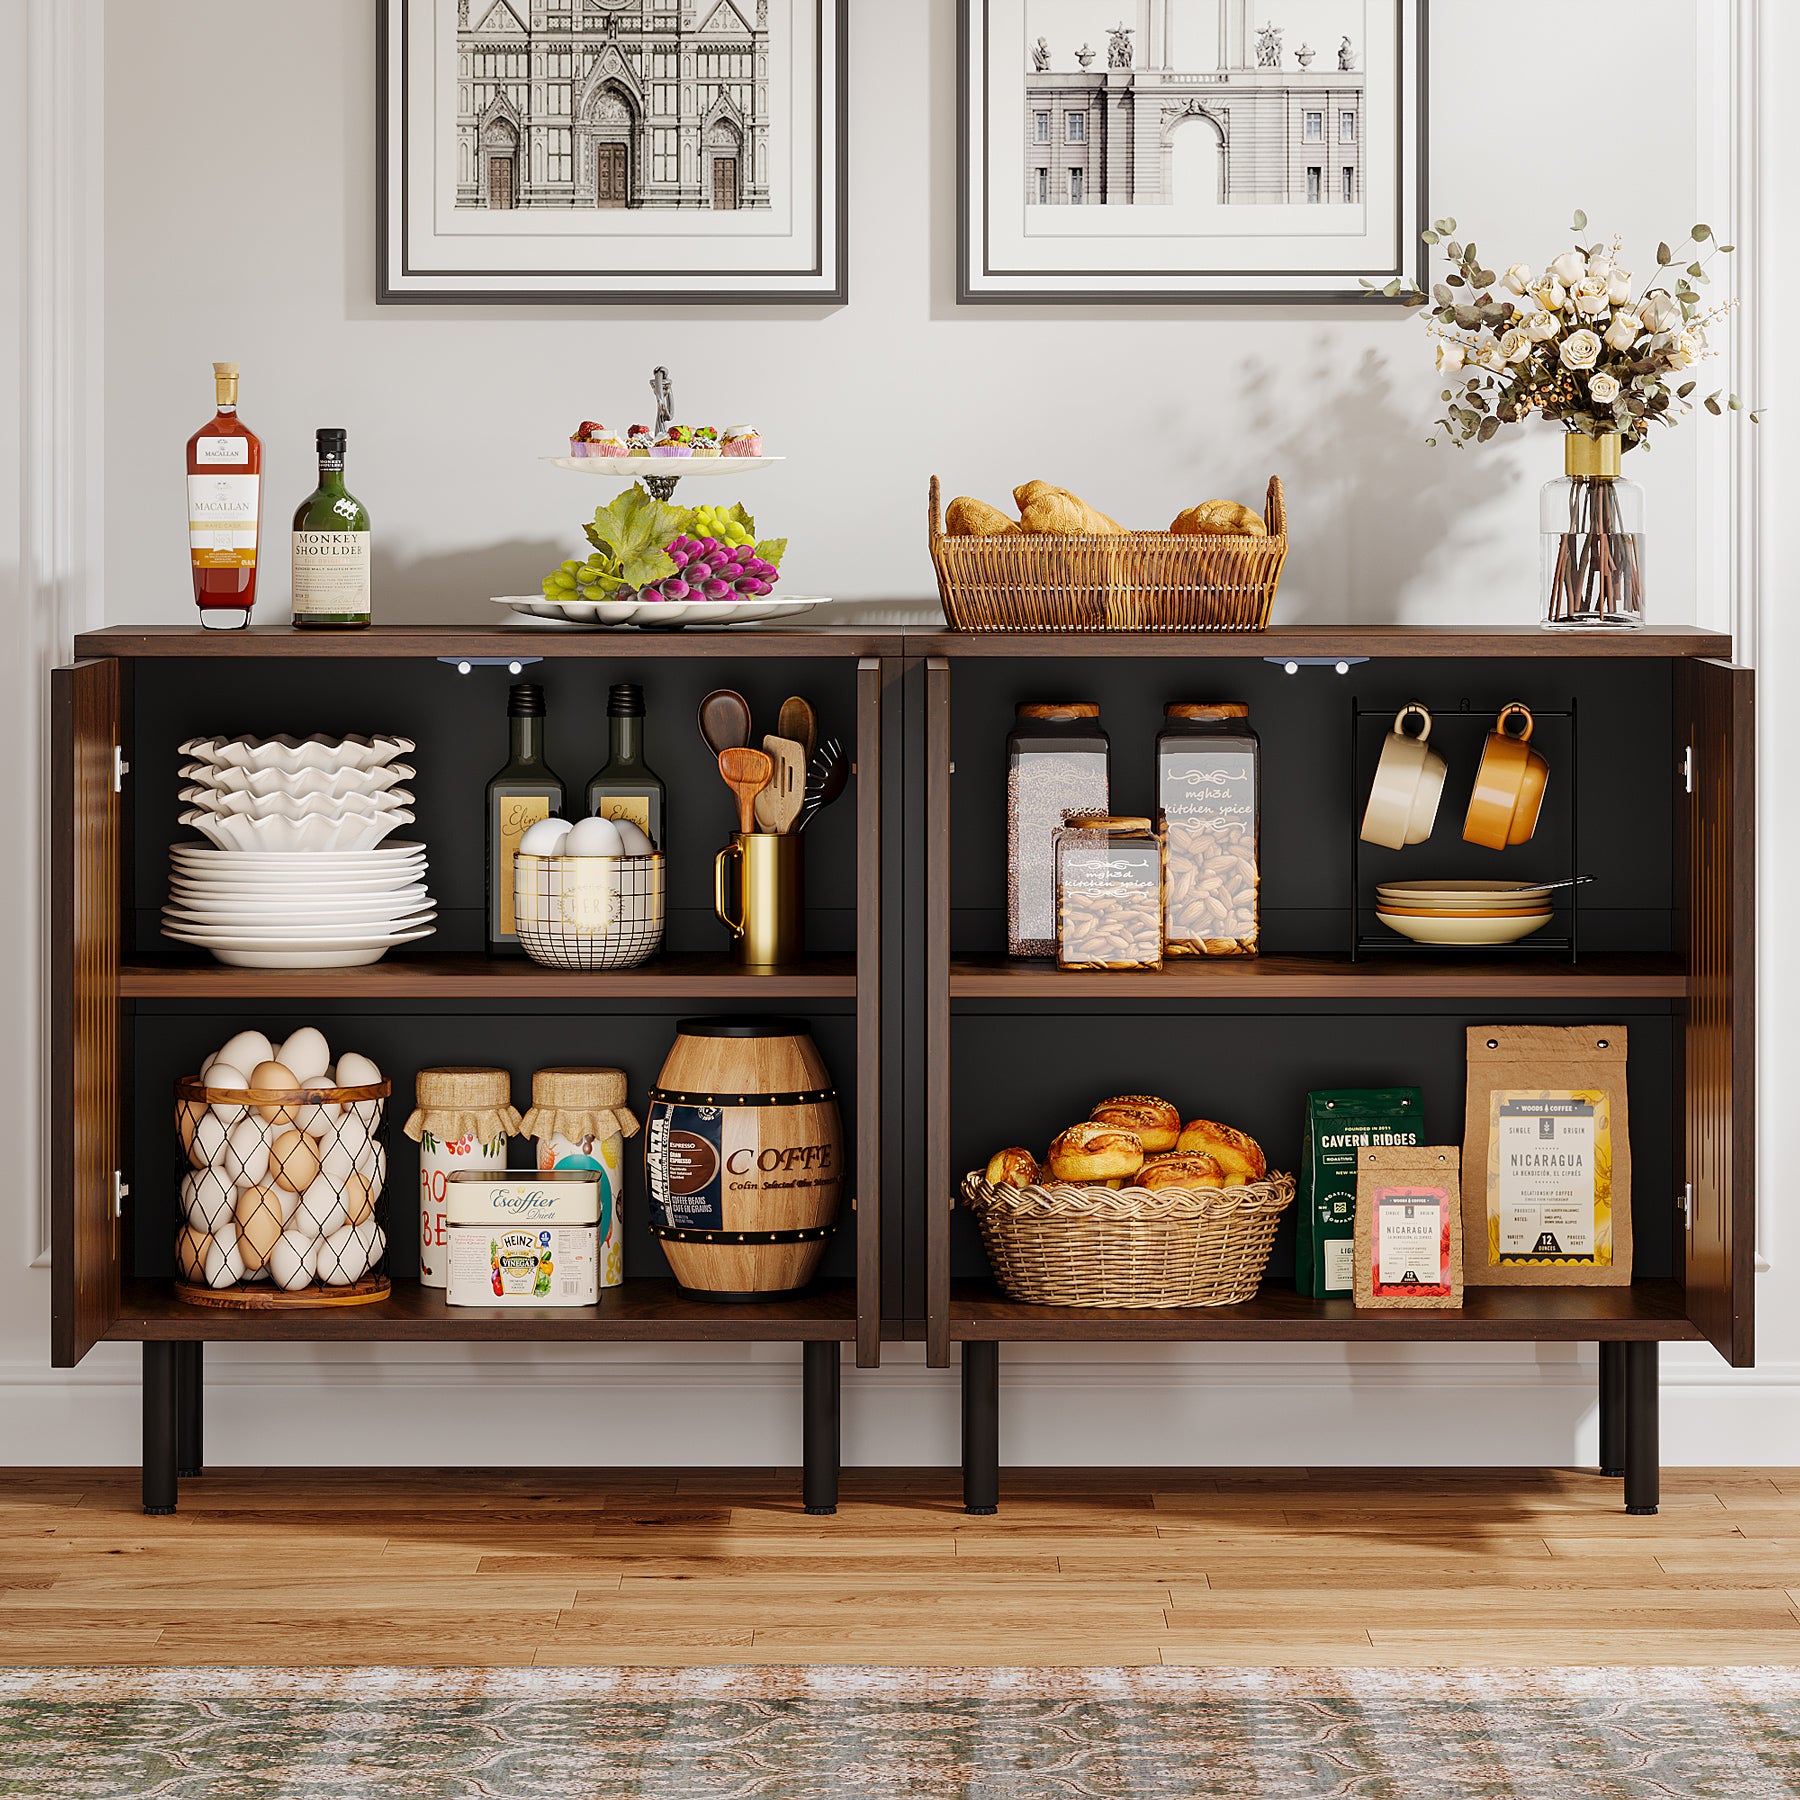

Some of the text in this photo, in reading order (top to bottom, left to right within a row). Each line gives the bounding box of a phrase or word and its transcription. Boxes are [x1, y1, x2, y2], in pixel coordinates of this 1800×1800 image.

[195, 503, 249, 511] MACALLAN
[299, 534, 358, 543] MONKEY
[295, 546, 363, 555] SHOULDER
[1185, 787, 1232, 801] mgh3d
[1164, 803, 1253, 816] kitchen spice
[1064, 880, 1154, 889] kitchen spice
[1321, 1132, 1417, 1148] CAVERN RIDGES
[647, 1118, 665, 1204] LAVAZZA
[1510, 1153, 1583, 1167] NICARAGUA
[421, 1169, 447, 1202] RO
[490, 1188, 560, 1215] Escoffier
[421, 1210, 448, 1247] BE
[1386, 1226, 1433, 1234] NICARAGUA
[504, 1235, 534, 1248] HEINZ
[1541, 1235, 1553, 1245] 12
[503, 1258, 535, 1267] VINEGAR
[1406, 1271, 1414, 1279] 12
